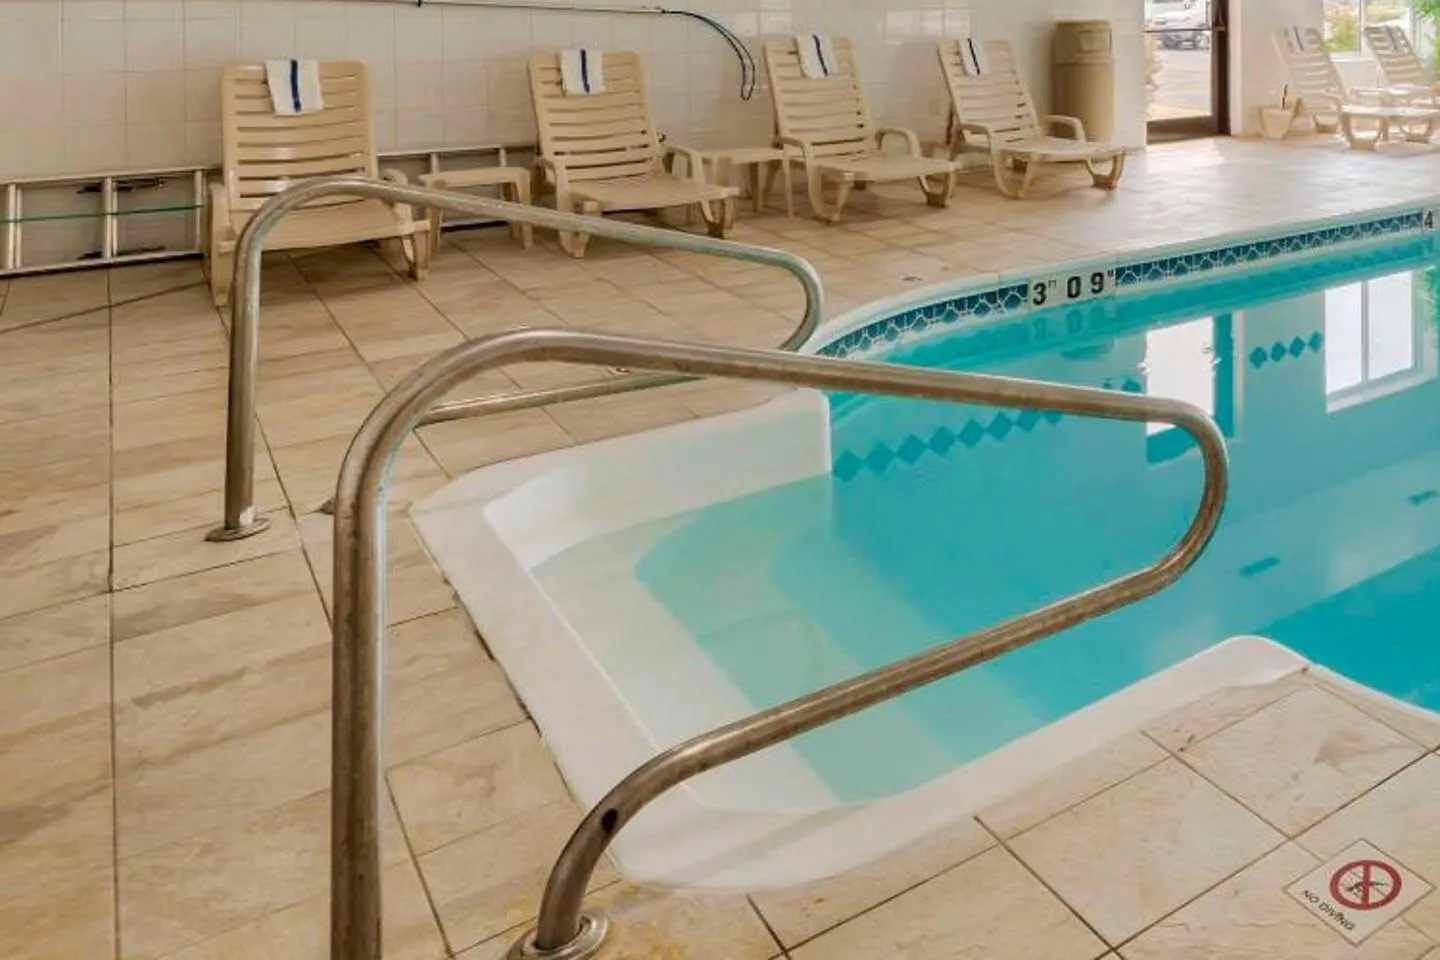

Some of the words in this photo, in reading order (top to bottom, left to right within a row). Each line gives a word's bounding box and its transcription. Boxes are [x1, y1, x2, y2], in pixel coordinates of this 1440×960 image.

[1425, 211, 1433, 229] 4
[1303, 890, 1320, 903] NO
[1319, 902, 1356, 930] DIVING
